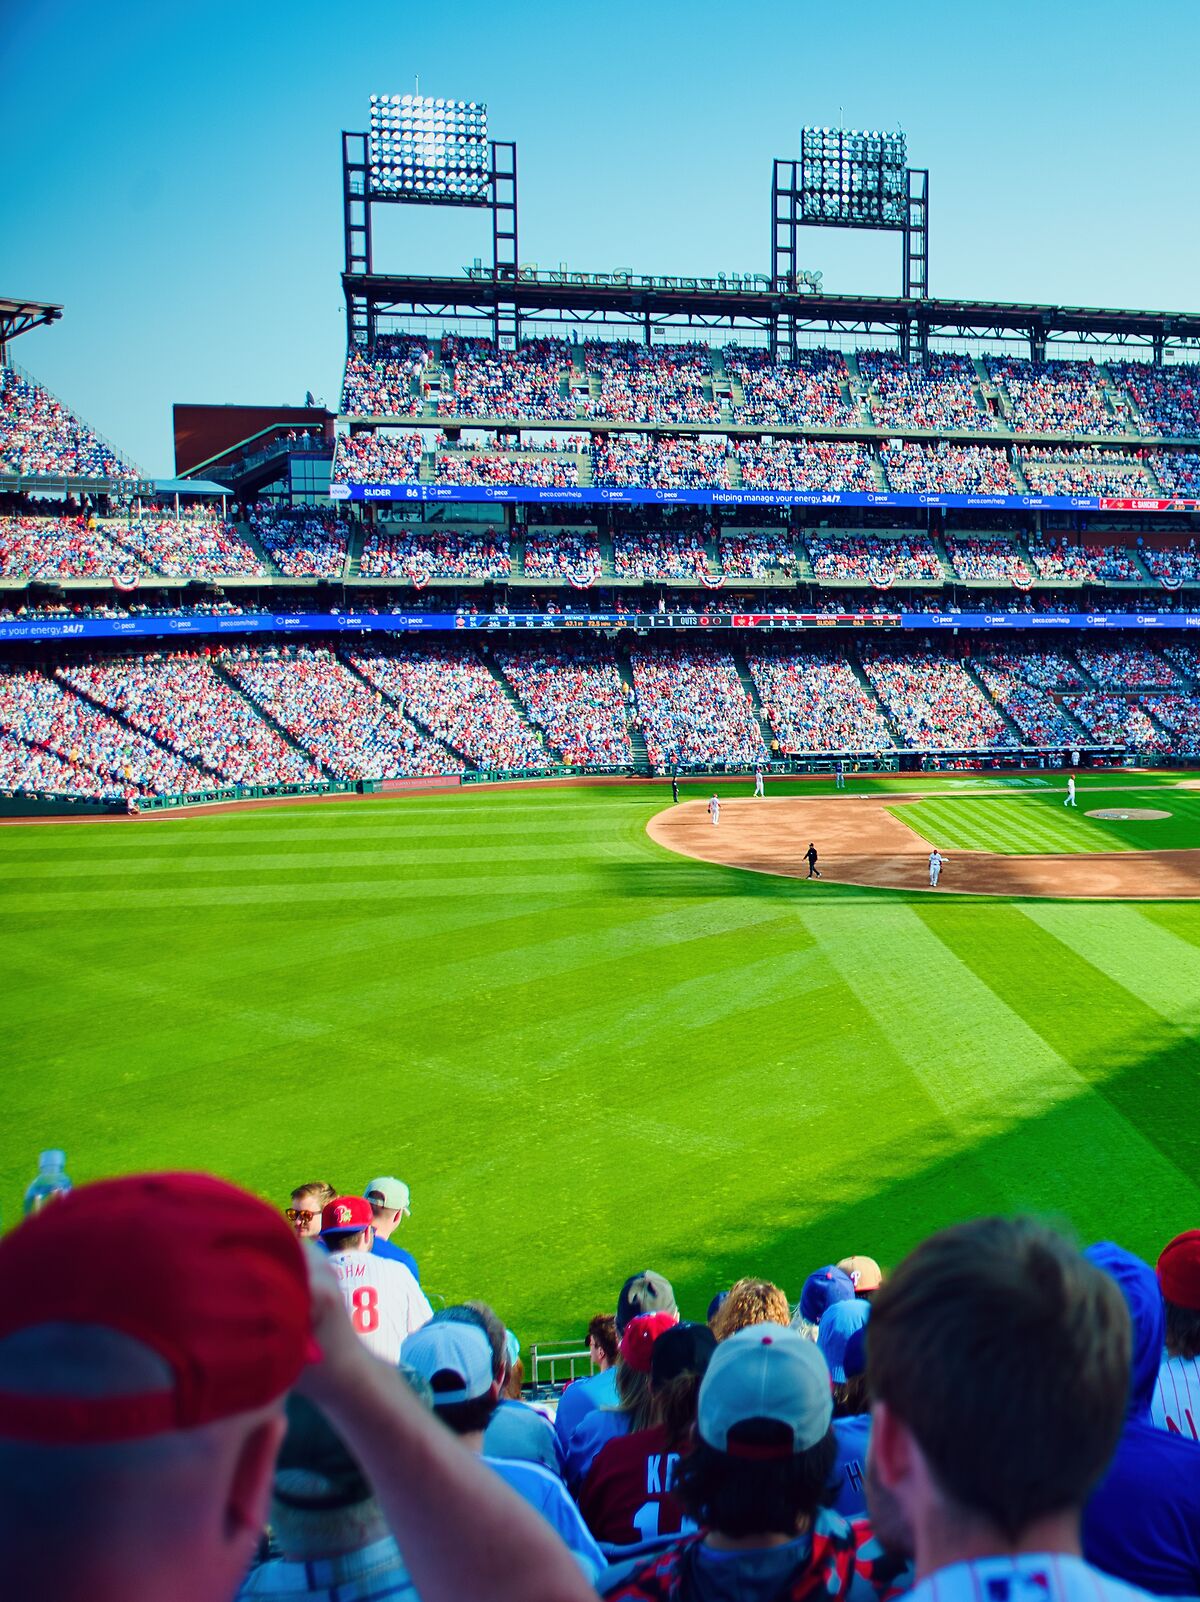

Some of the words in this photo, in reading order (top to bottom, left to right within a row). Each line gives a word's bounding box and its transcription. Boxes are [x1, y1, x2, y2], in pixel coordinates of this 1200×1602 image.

[406, 489, 418, 497] 86
[713, 493, 742, 504] Helping
[743, 495, 774, 503] manage
[775, 495, 793, 503] your
[178, 621, 191, 629] peco
[681, 617, 697, 625] OUTS
[9, 628, 28, 636] your
[851, 1270, 861, 1287] P
[352, 1285, 379, 1334] 8
